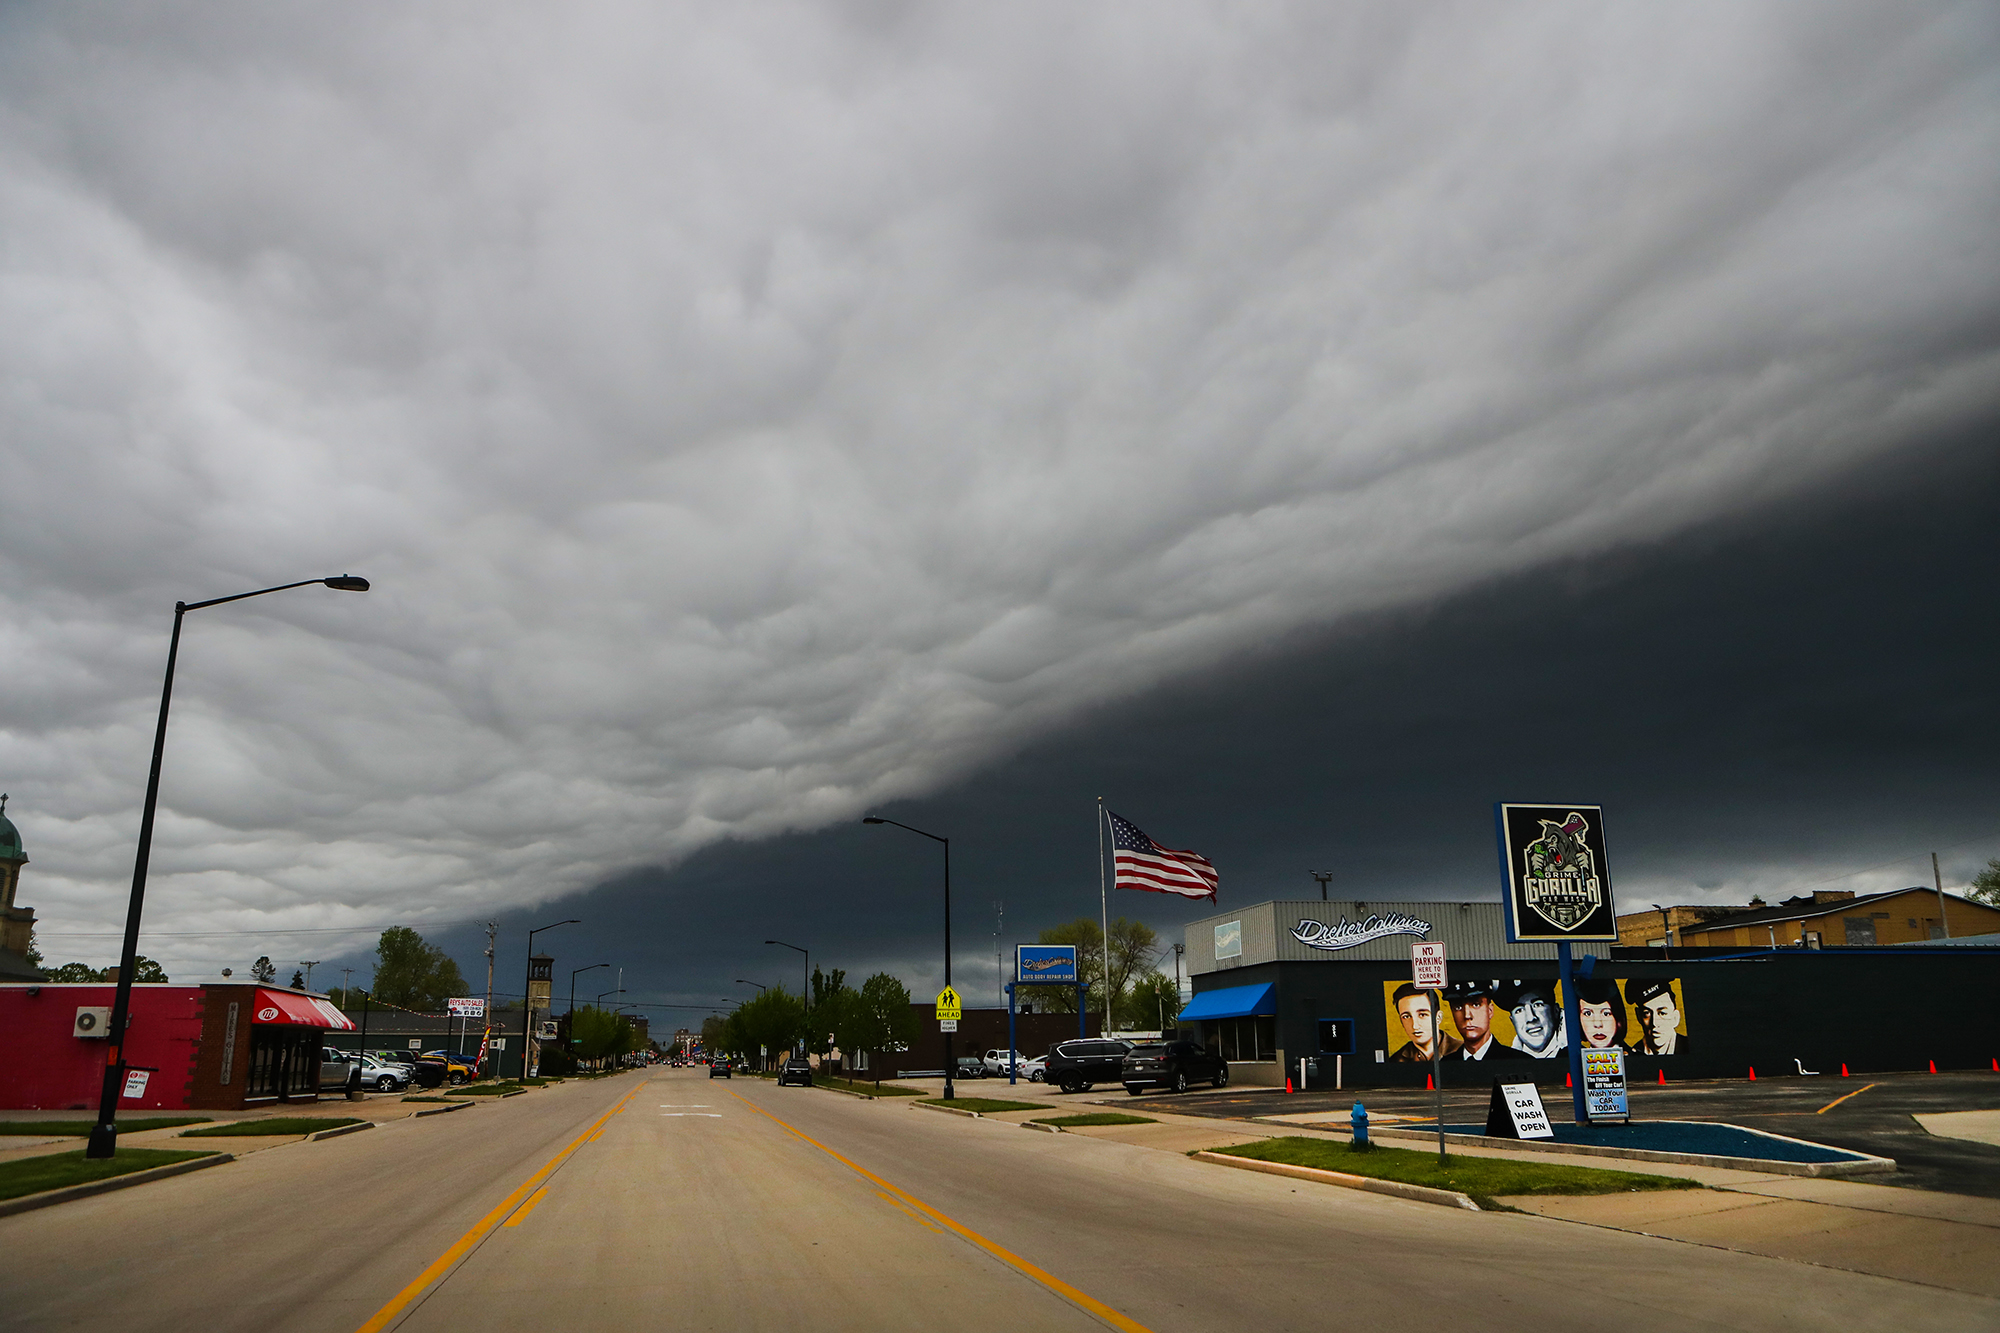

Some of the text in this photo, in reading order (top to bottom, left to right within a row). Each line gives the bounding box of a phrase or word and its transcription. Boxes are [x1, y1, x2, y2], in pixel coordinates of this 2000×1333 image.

[1527, 879, 1598, 903] GORILLA
[1296, 915, 1362, 942] Dreher
[1362, 911, 1432, 933] Collision
[1422, 947, 1433, 956] NO
[1415, 957, 1442, 966] PARKING
[1586, 1053, 1618, 1063] SALT
[1588, 1063, 1619, 1074] EATS
[1514, 1111, 1543, 1119] WASH
[1520, 1123, 1546, 1131] OPEN
